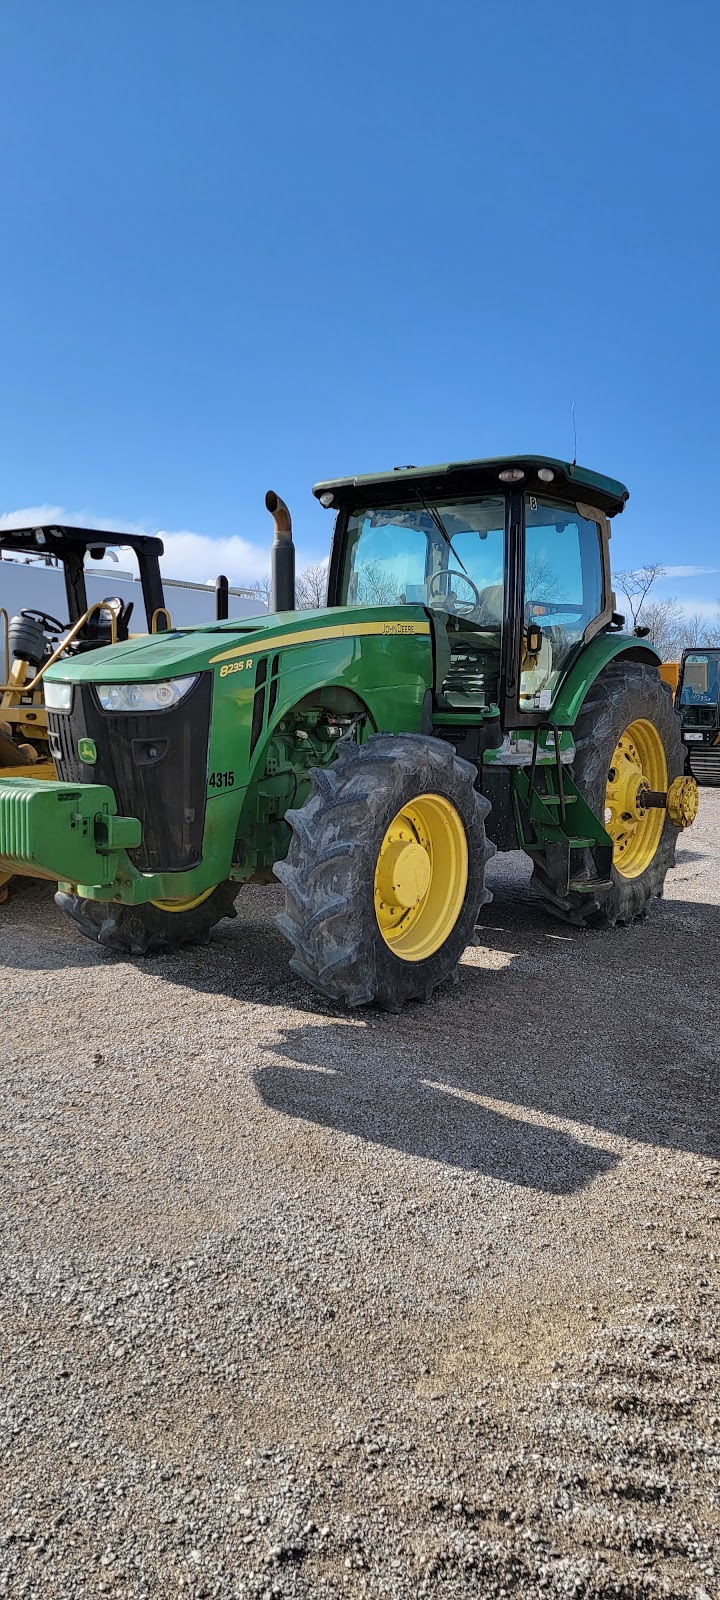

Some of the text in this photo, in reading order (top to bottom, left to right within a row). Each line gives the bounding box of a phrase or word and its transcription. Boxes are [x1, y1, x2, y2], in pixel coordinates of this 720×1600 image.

[530, 496, 537, 510] 8
[219, 664, 244, 678] 8235
[208, 770, 235, 788] 4315
